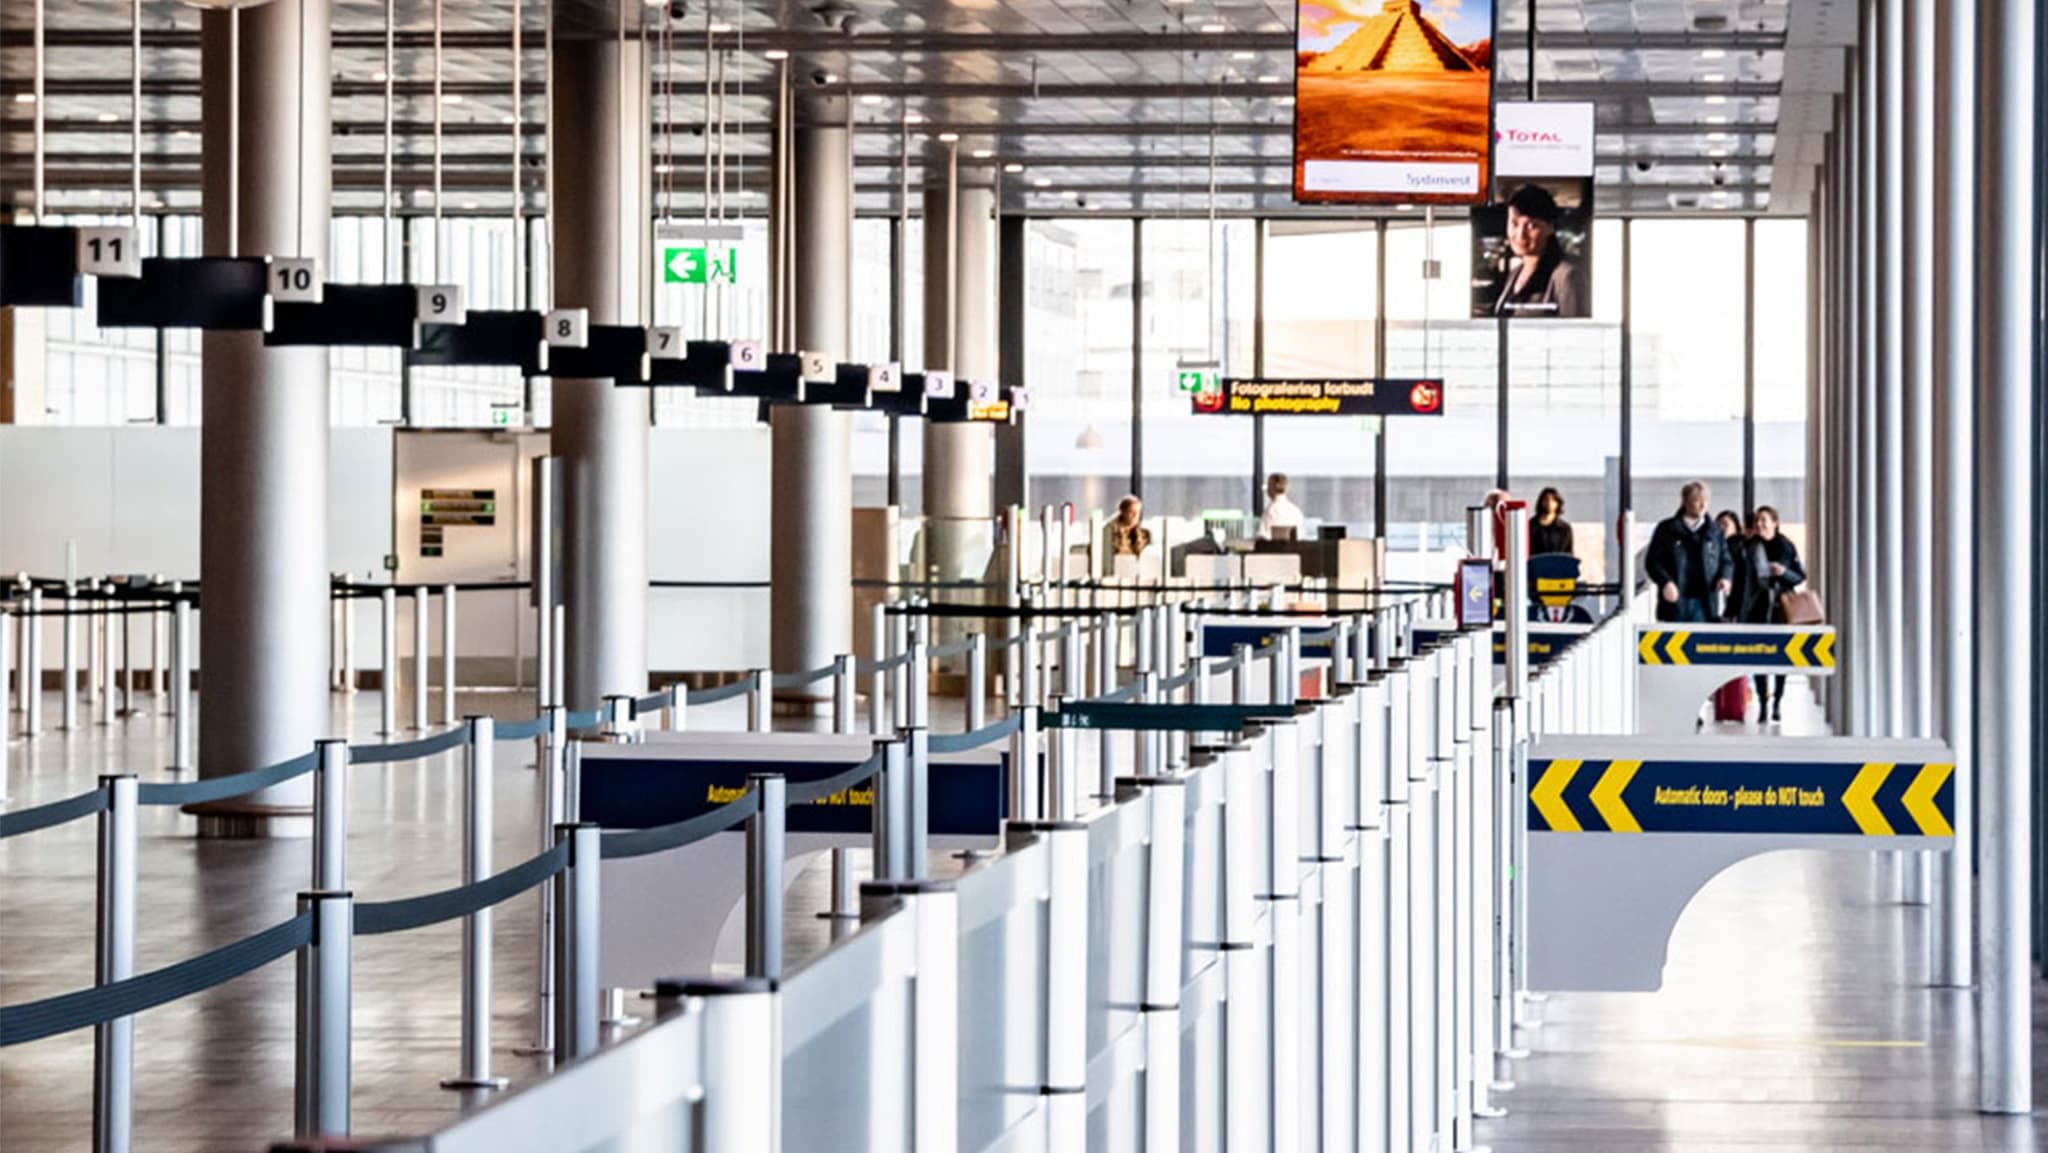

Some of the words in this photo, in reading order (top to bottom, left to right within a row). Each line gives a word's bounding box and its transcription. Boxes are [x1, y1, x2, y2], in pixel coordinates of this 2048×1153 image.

[1507, 129, 1561, 142] TOTAL
[88, 238, 122, 262] 11
[278, 268, 310, 290] 10
[431, 294, 446, 314] 9
[558, 320, 571, 337] 8
[658, 333, 671, 349] 7
[741, 346, 753, 362] 6
[812, 360, 823, 374] 5
[879, 370, 889, 383] 4
[935, 378, 943, 391] 3
[979, 385, 988, 398] 2
[1231, 381, 1320, 397] Fotografering
[1324, 382, 1374, 395] forbudt
[1231, 397, 1250, 410] No
[1254, 397, 1340, 412] photography
[1654, 785, 1700, 805] Automatic
[1702, 785, 1728, 805] doors
[1734, 785, 1762, 810] please
[1765, 785, 1777, 806] do
[1778, 786, 1797, 806] NOT
[1798, 786, 1824, 806] touch
